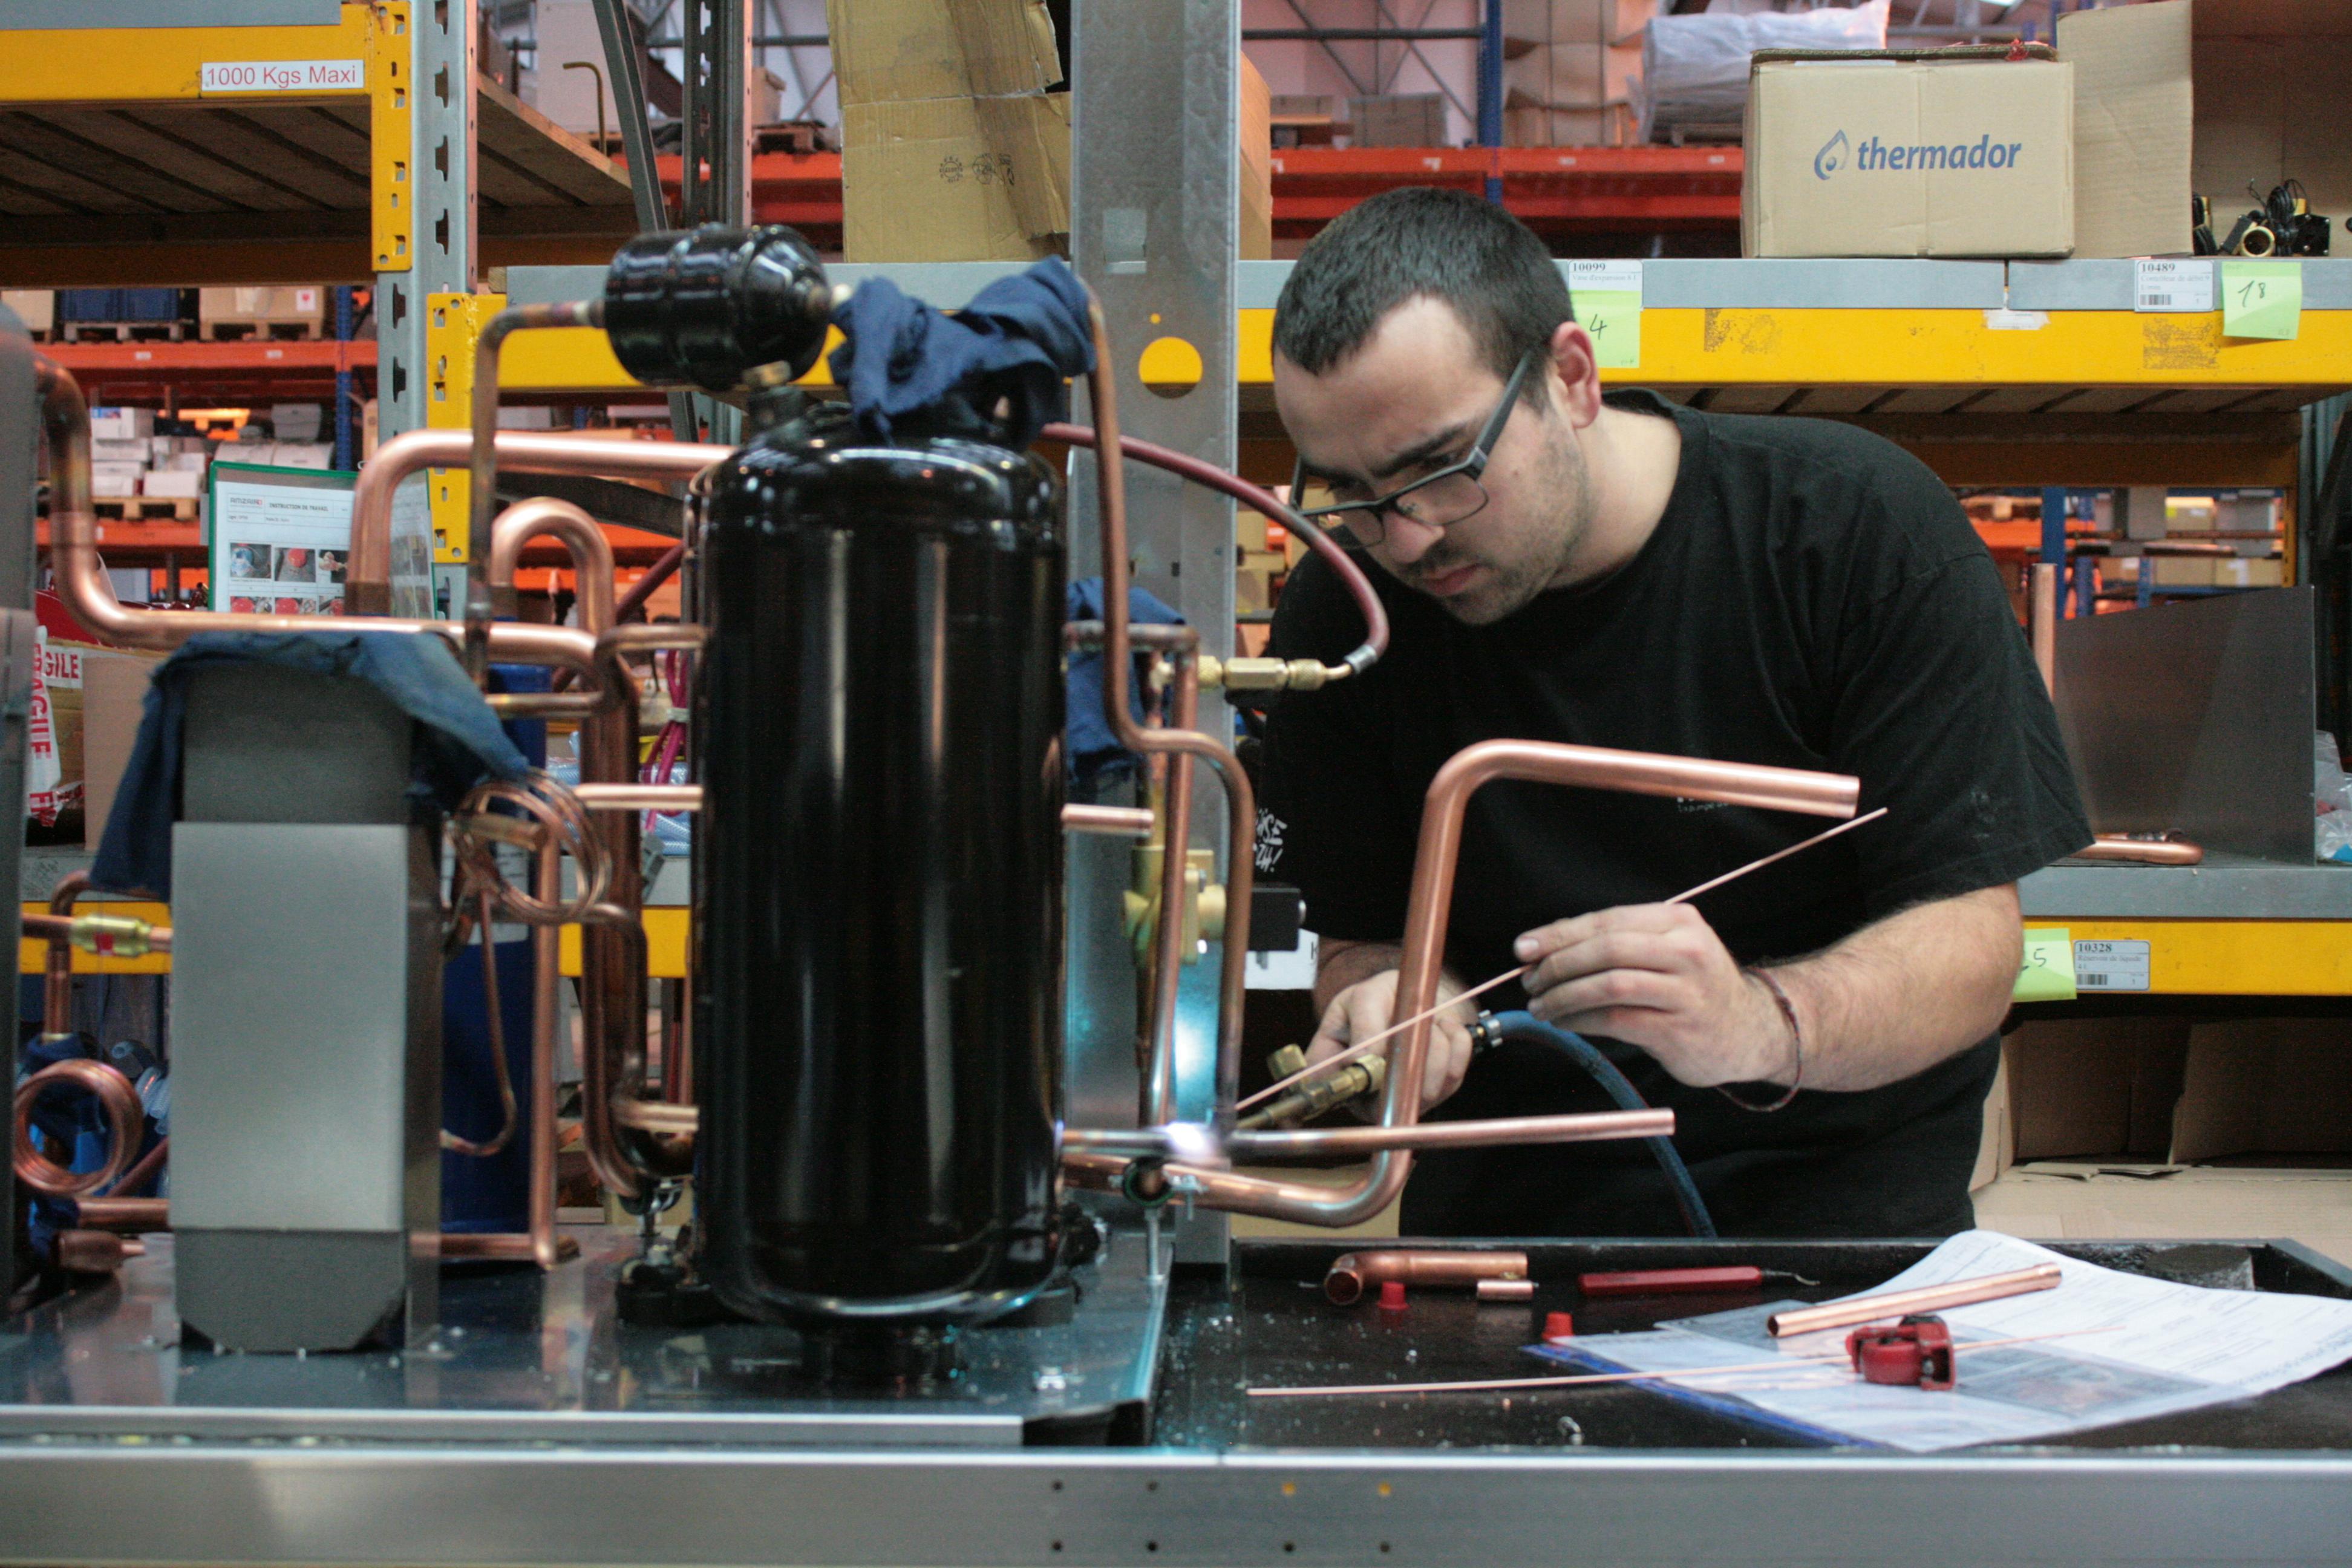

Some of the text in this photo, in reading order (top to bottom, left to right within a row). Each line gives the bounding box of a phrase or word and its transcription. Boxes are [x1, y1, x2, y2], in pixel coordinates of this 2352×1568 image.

[207, 65, 356, 88] 1000 Kgs Maxi
[1858, 134, 2022, 170] thermador
[1573, 263, 1606, 272] 10099
[2141, 263, 2176, 272] 10489
[1589, 313, 1607, 341] 4
[45, 652, 79, 679] GILE
[2079, 942, 2112, 953] 10328
